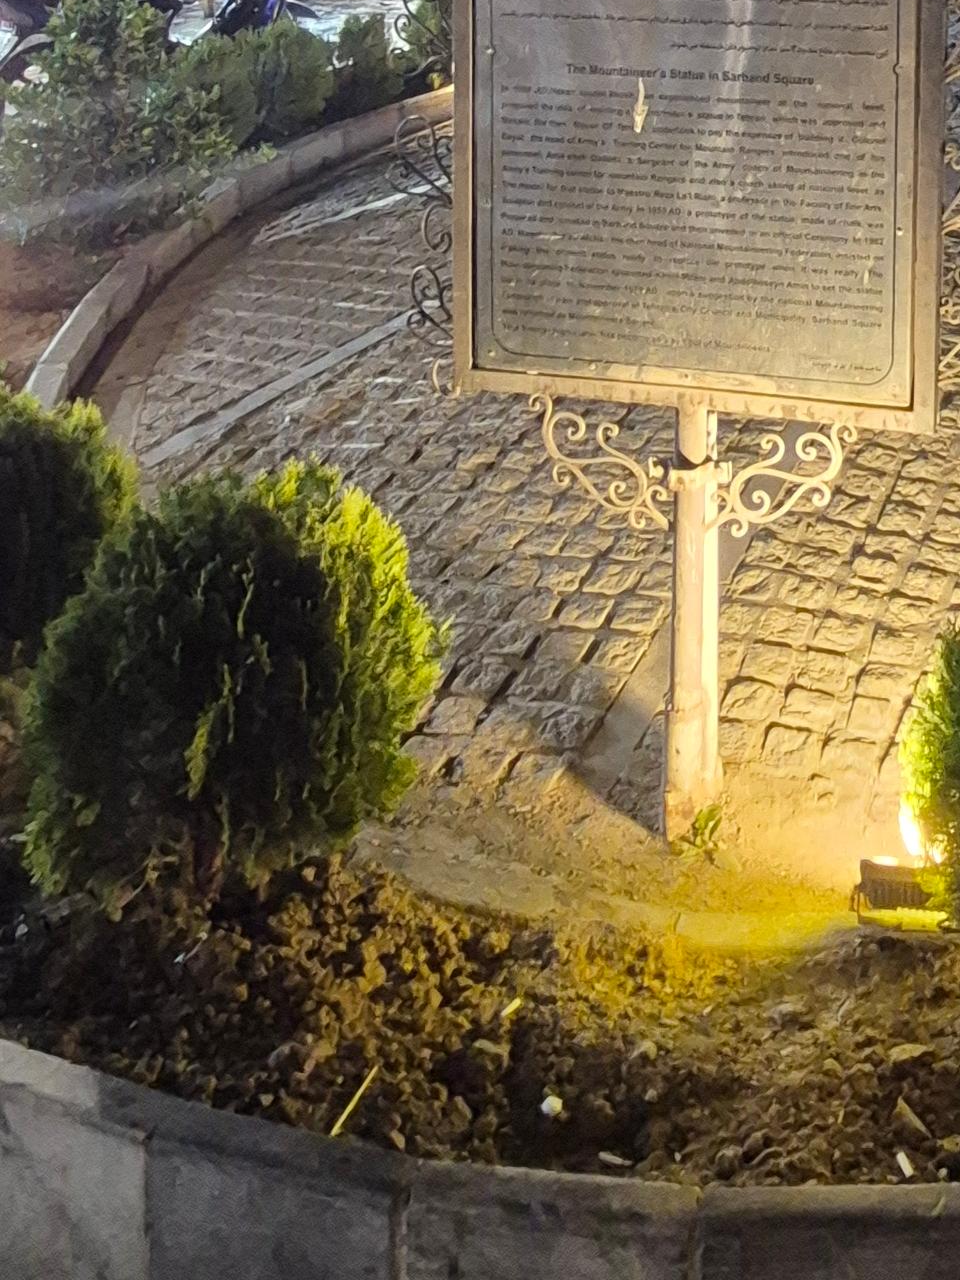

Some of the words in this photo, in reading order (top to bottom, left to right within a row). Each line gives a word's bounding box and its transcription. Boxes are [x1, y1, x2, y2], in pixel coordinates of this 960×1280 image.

[566, 63, 586, 74] The
[669, 69, 705, 80] Statue
[708, 70, 720, 81] in
[722, 71, 770, 84] Sarband
[773, 73, 815, 87] Square
